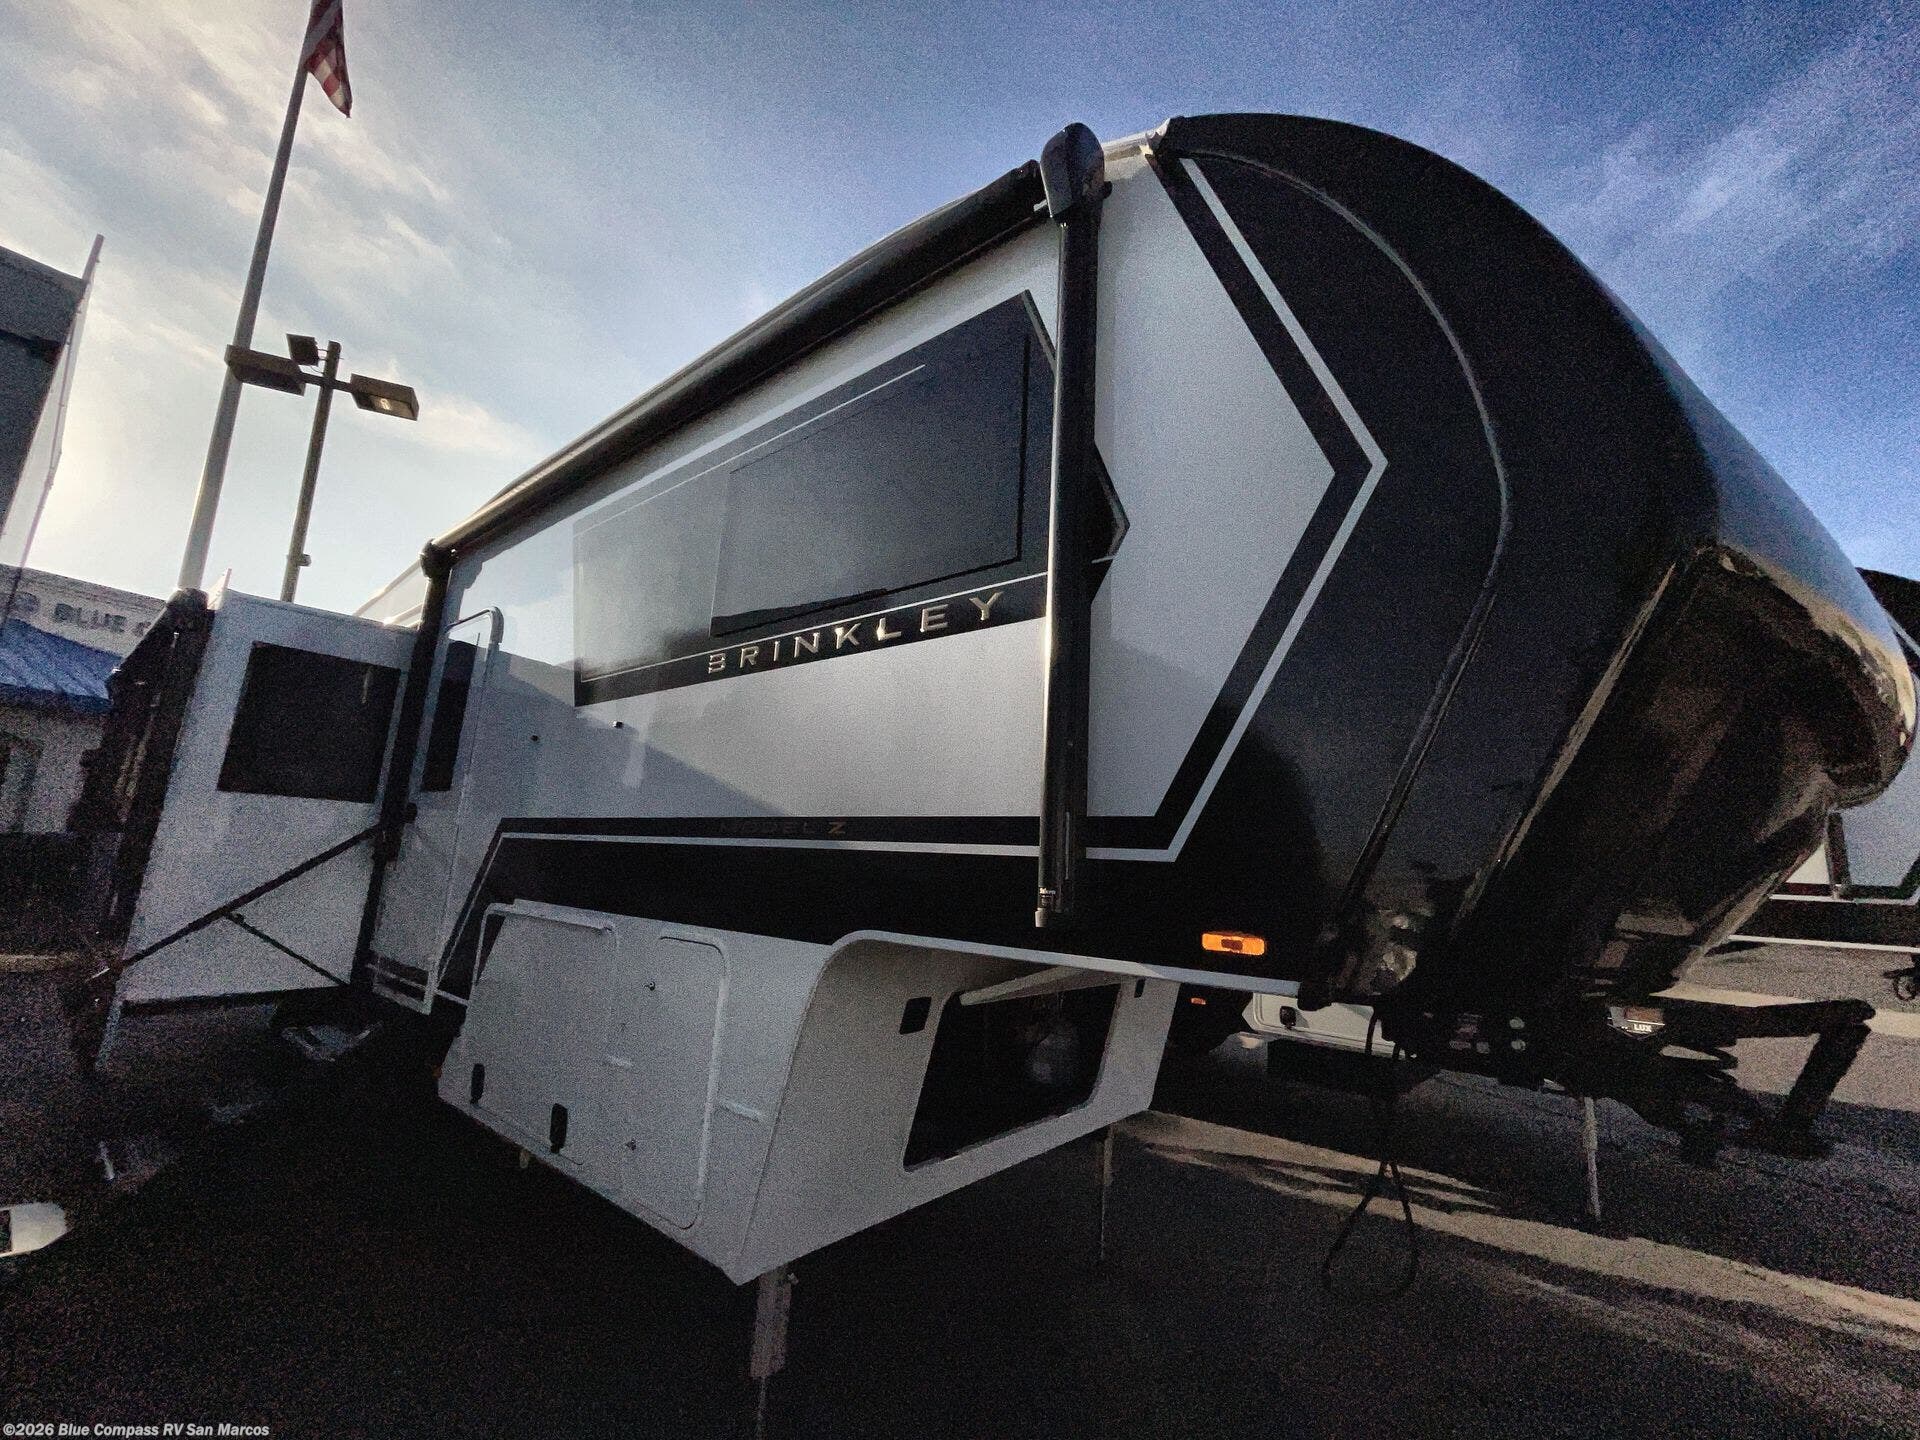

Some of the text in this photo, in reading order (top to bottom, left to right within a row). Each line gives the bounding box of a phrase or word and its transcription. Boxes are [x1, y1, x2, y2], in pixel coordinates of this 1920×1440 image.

[54, 602, 128, 633] BLUE
[707, 591, 1005, 674] BRINKLEY
[719, 821, 847, 835] MODEL Z
